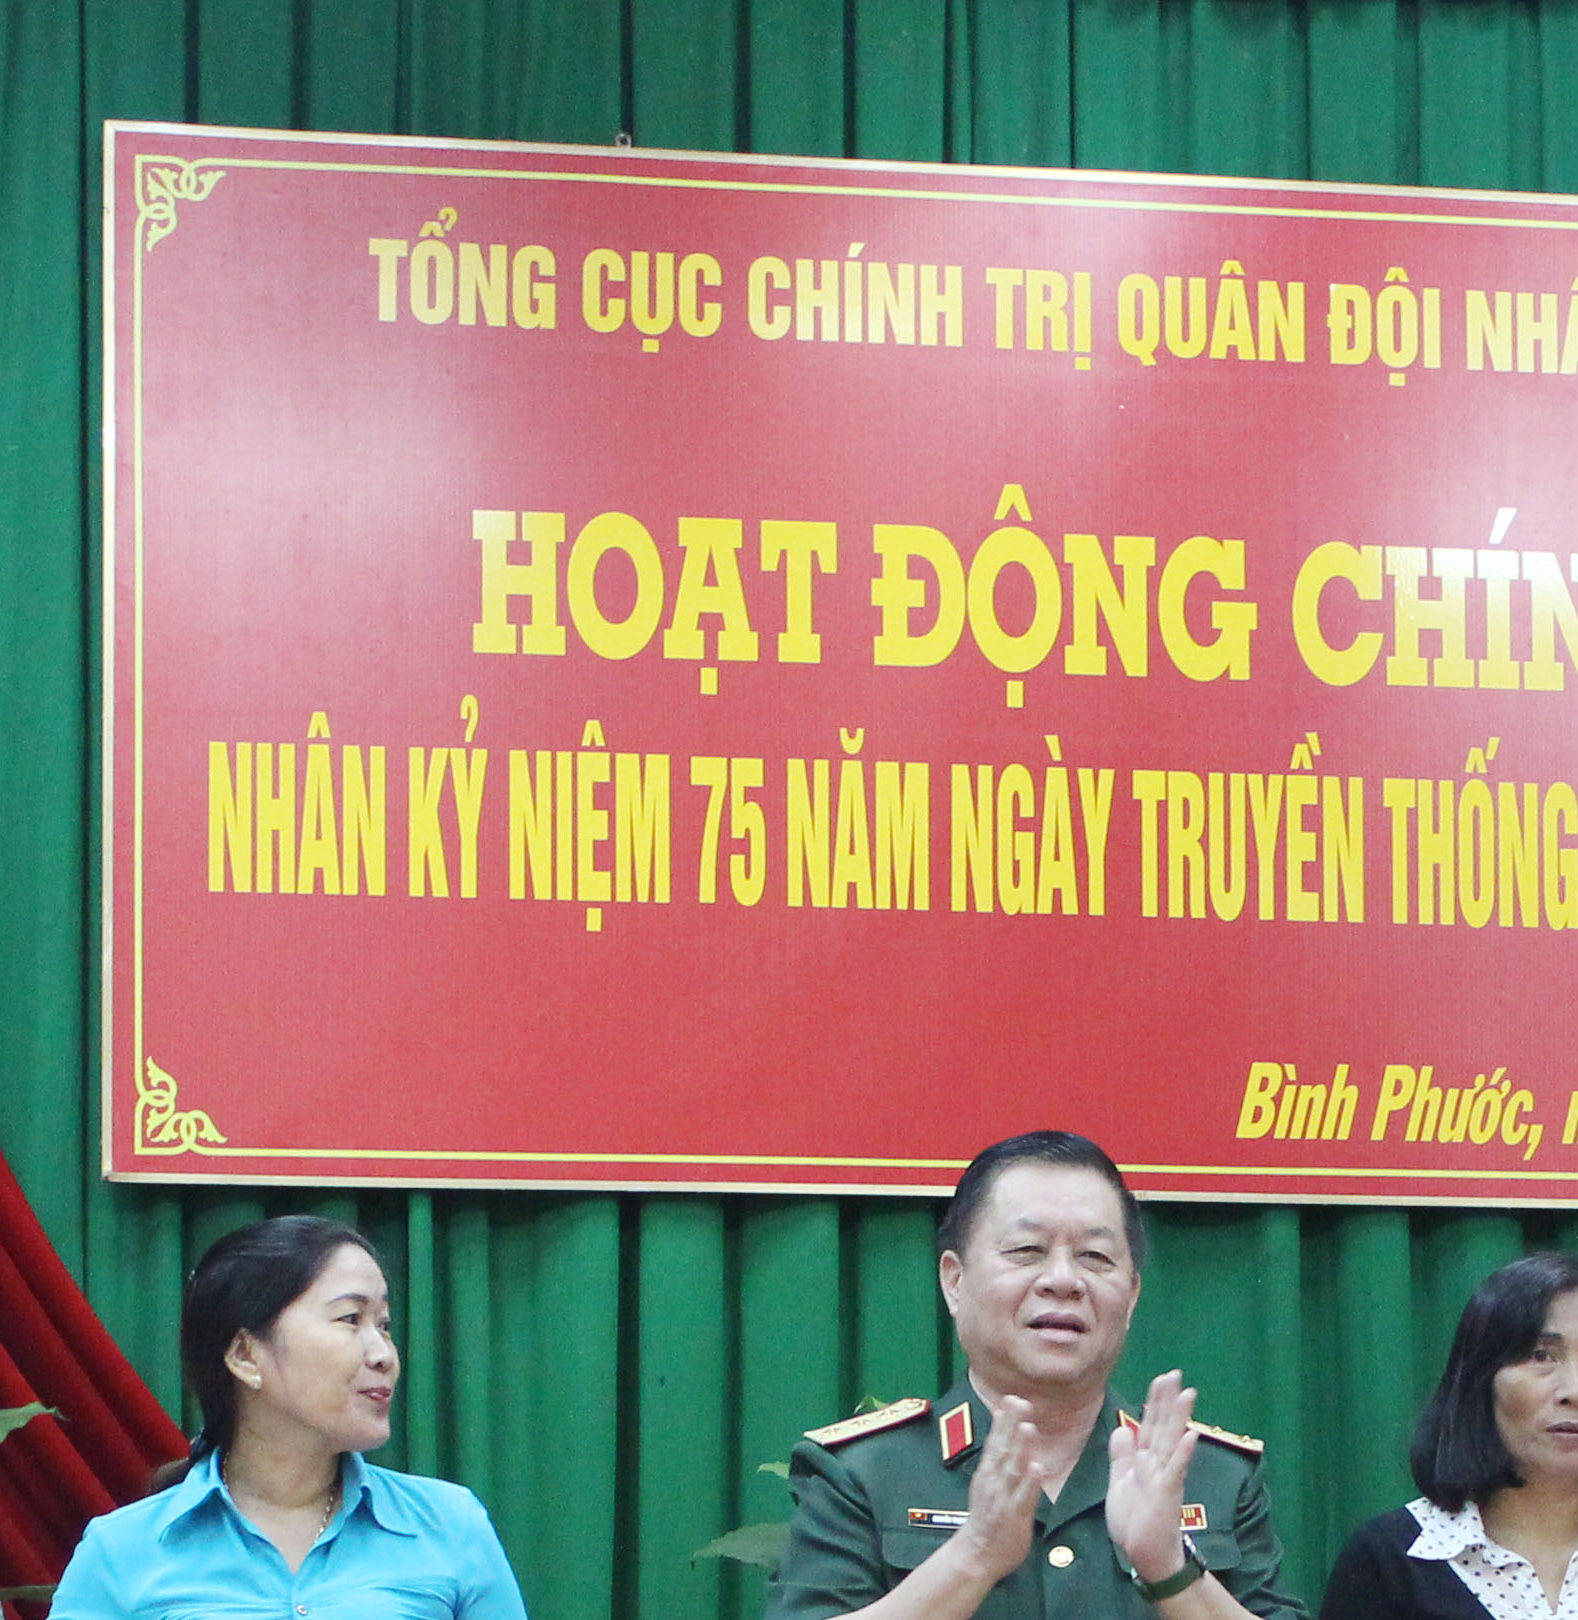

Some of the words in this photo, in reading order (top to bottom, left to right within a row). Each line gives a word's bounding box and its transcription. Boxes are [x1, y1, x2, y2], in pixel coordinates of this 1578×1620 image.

[368, 207, 556, 331] TỔNG
[582, 251, 721, 353] CỤC
[748, 246, 964, 346] CHÍNH
[986, 266, 1092, 370] TRỊ
[1118, 261, 1305, 366] QUÂN
[1326, 266, 1440, 387] ĐỘI
[472, 508, 837, 694] HOẠT
[871, 485, 1258, 707] ĐỘNG
[208, 711, 386, 898] NHÂN
[408, 695, 488, 901] KỶ
[509, 719, 671, 931] NIỆM
[690, 755, 765, 907] 75
[787, 728, 931, 911] NĂM
[951, 735, 1115, 915] NGÀY
[1132, 732, 1364, 922] TRUYỀN
[1384, 737, 1578, 931] THỐNG
[1238, 1061, 1359, 1141] Bình
[1371, 1066, 1543, 1160] Phước,
